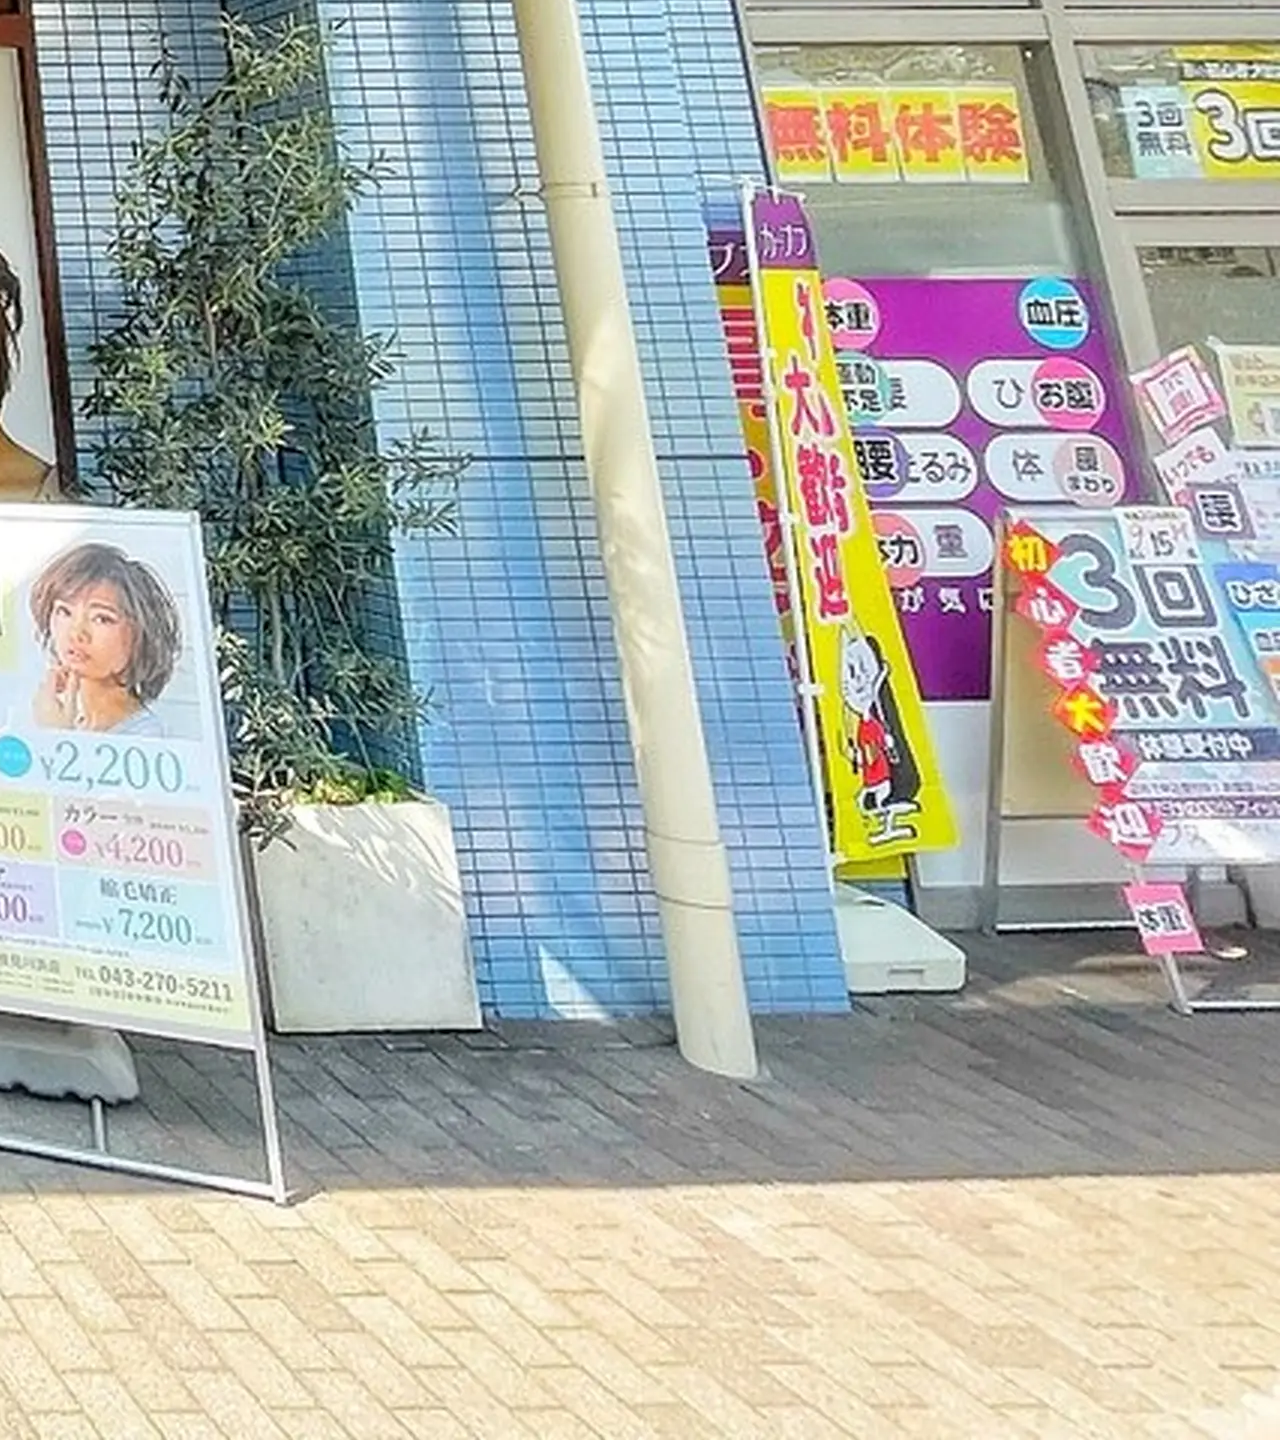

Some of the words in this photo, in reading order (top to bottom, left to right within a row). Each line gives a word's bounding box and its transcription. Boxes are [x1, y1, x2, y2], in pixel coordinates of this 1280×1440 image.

[766, 100, 1024, 164] 無料体験
[1134, 101, 1183, 128] 3回
[1026, 299, 1084, 328] 血圧
[1056, 533, 1218, 629] 3回
[1090, 637, 1247, 720] 無料
[64, 803, 119, 824] カラー
[98, 965, 234, 1002] 043-270-5211
